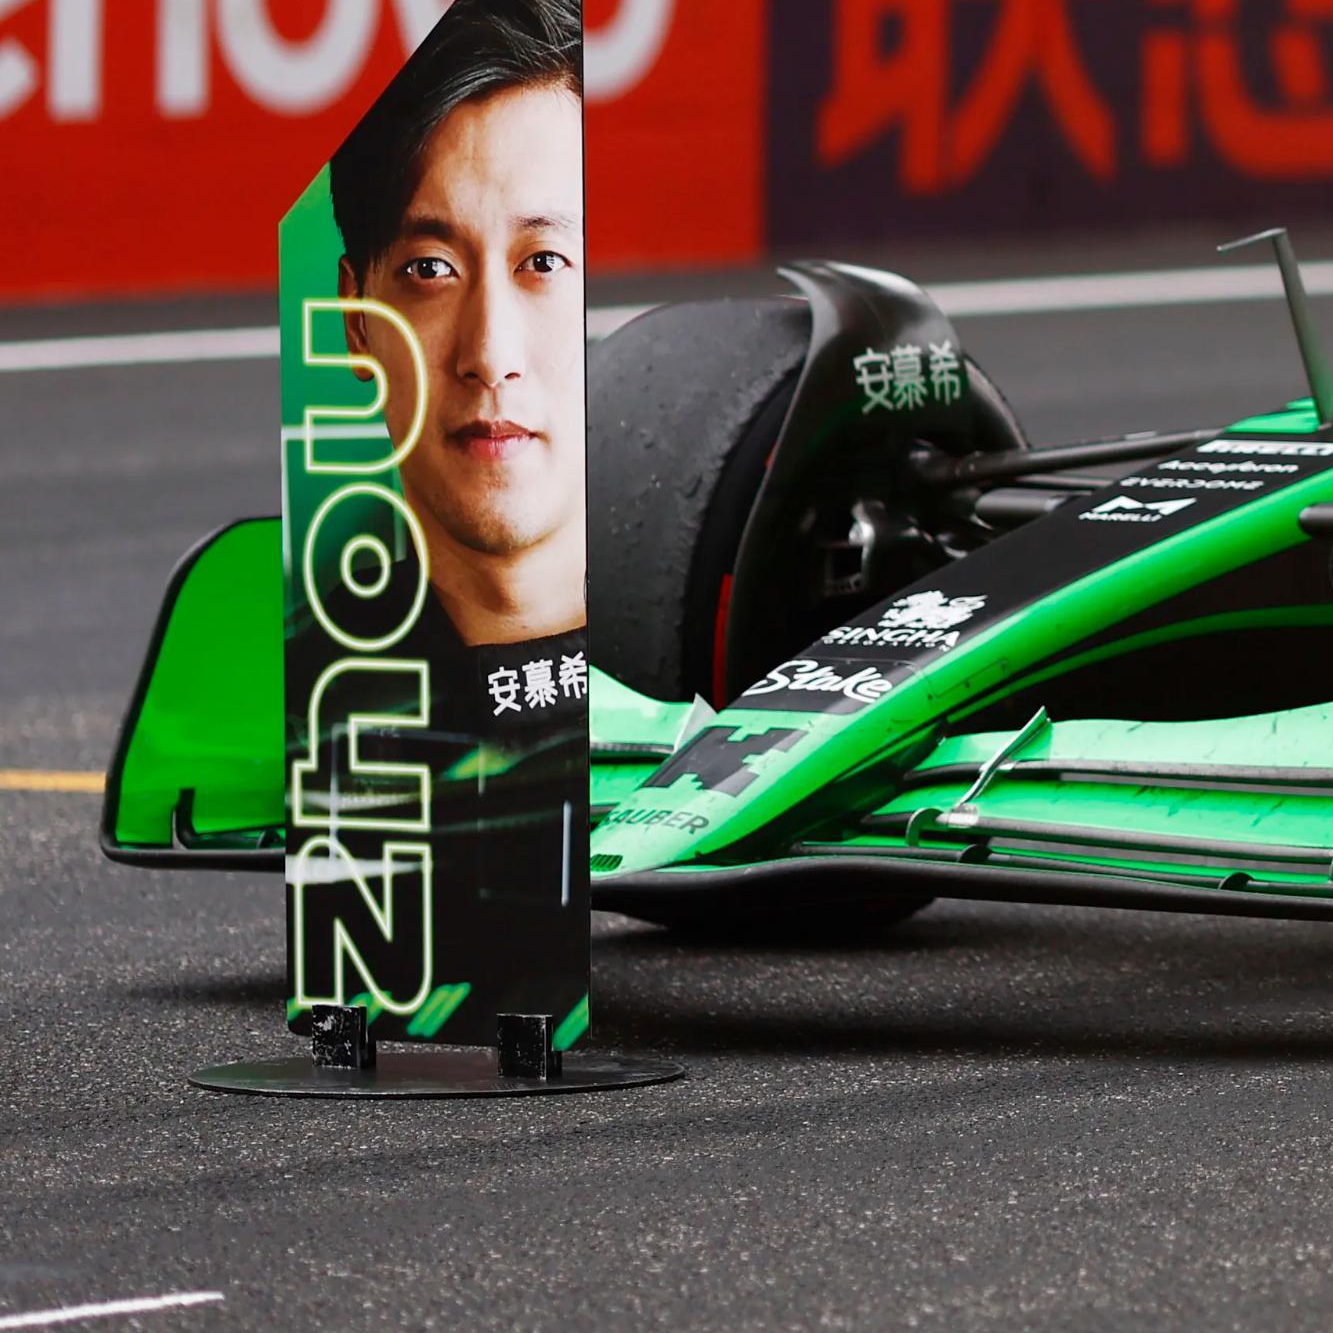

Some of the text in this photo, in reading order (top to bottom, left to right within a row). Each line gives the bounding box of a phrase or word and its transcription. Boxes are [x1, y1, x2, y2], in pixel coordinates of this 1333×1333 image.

[852, 338, 961, 416] 安慕希
[826, 626, 961, 648] SINGHA
[487, 650, 588, 717] 安慕希
[741, 659, 894, 704] Stake
